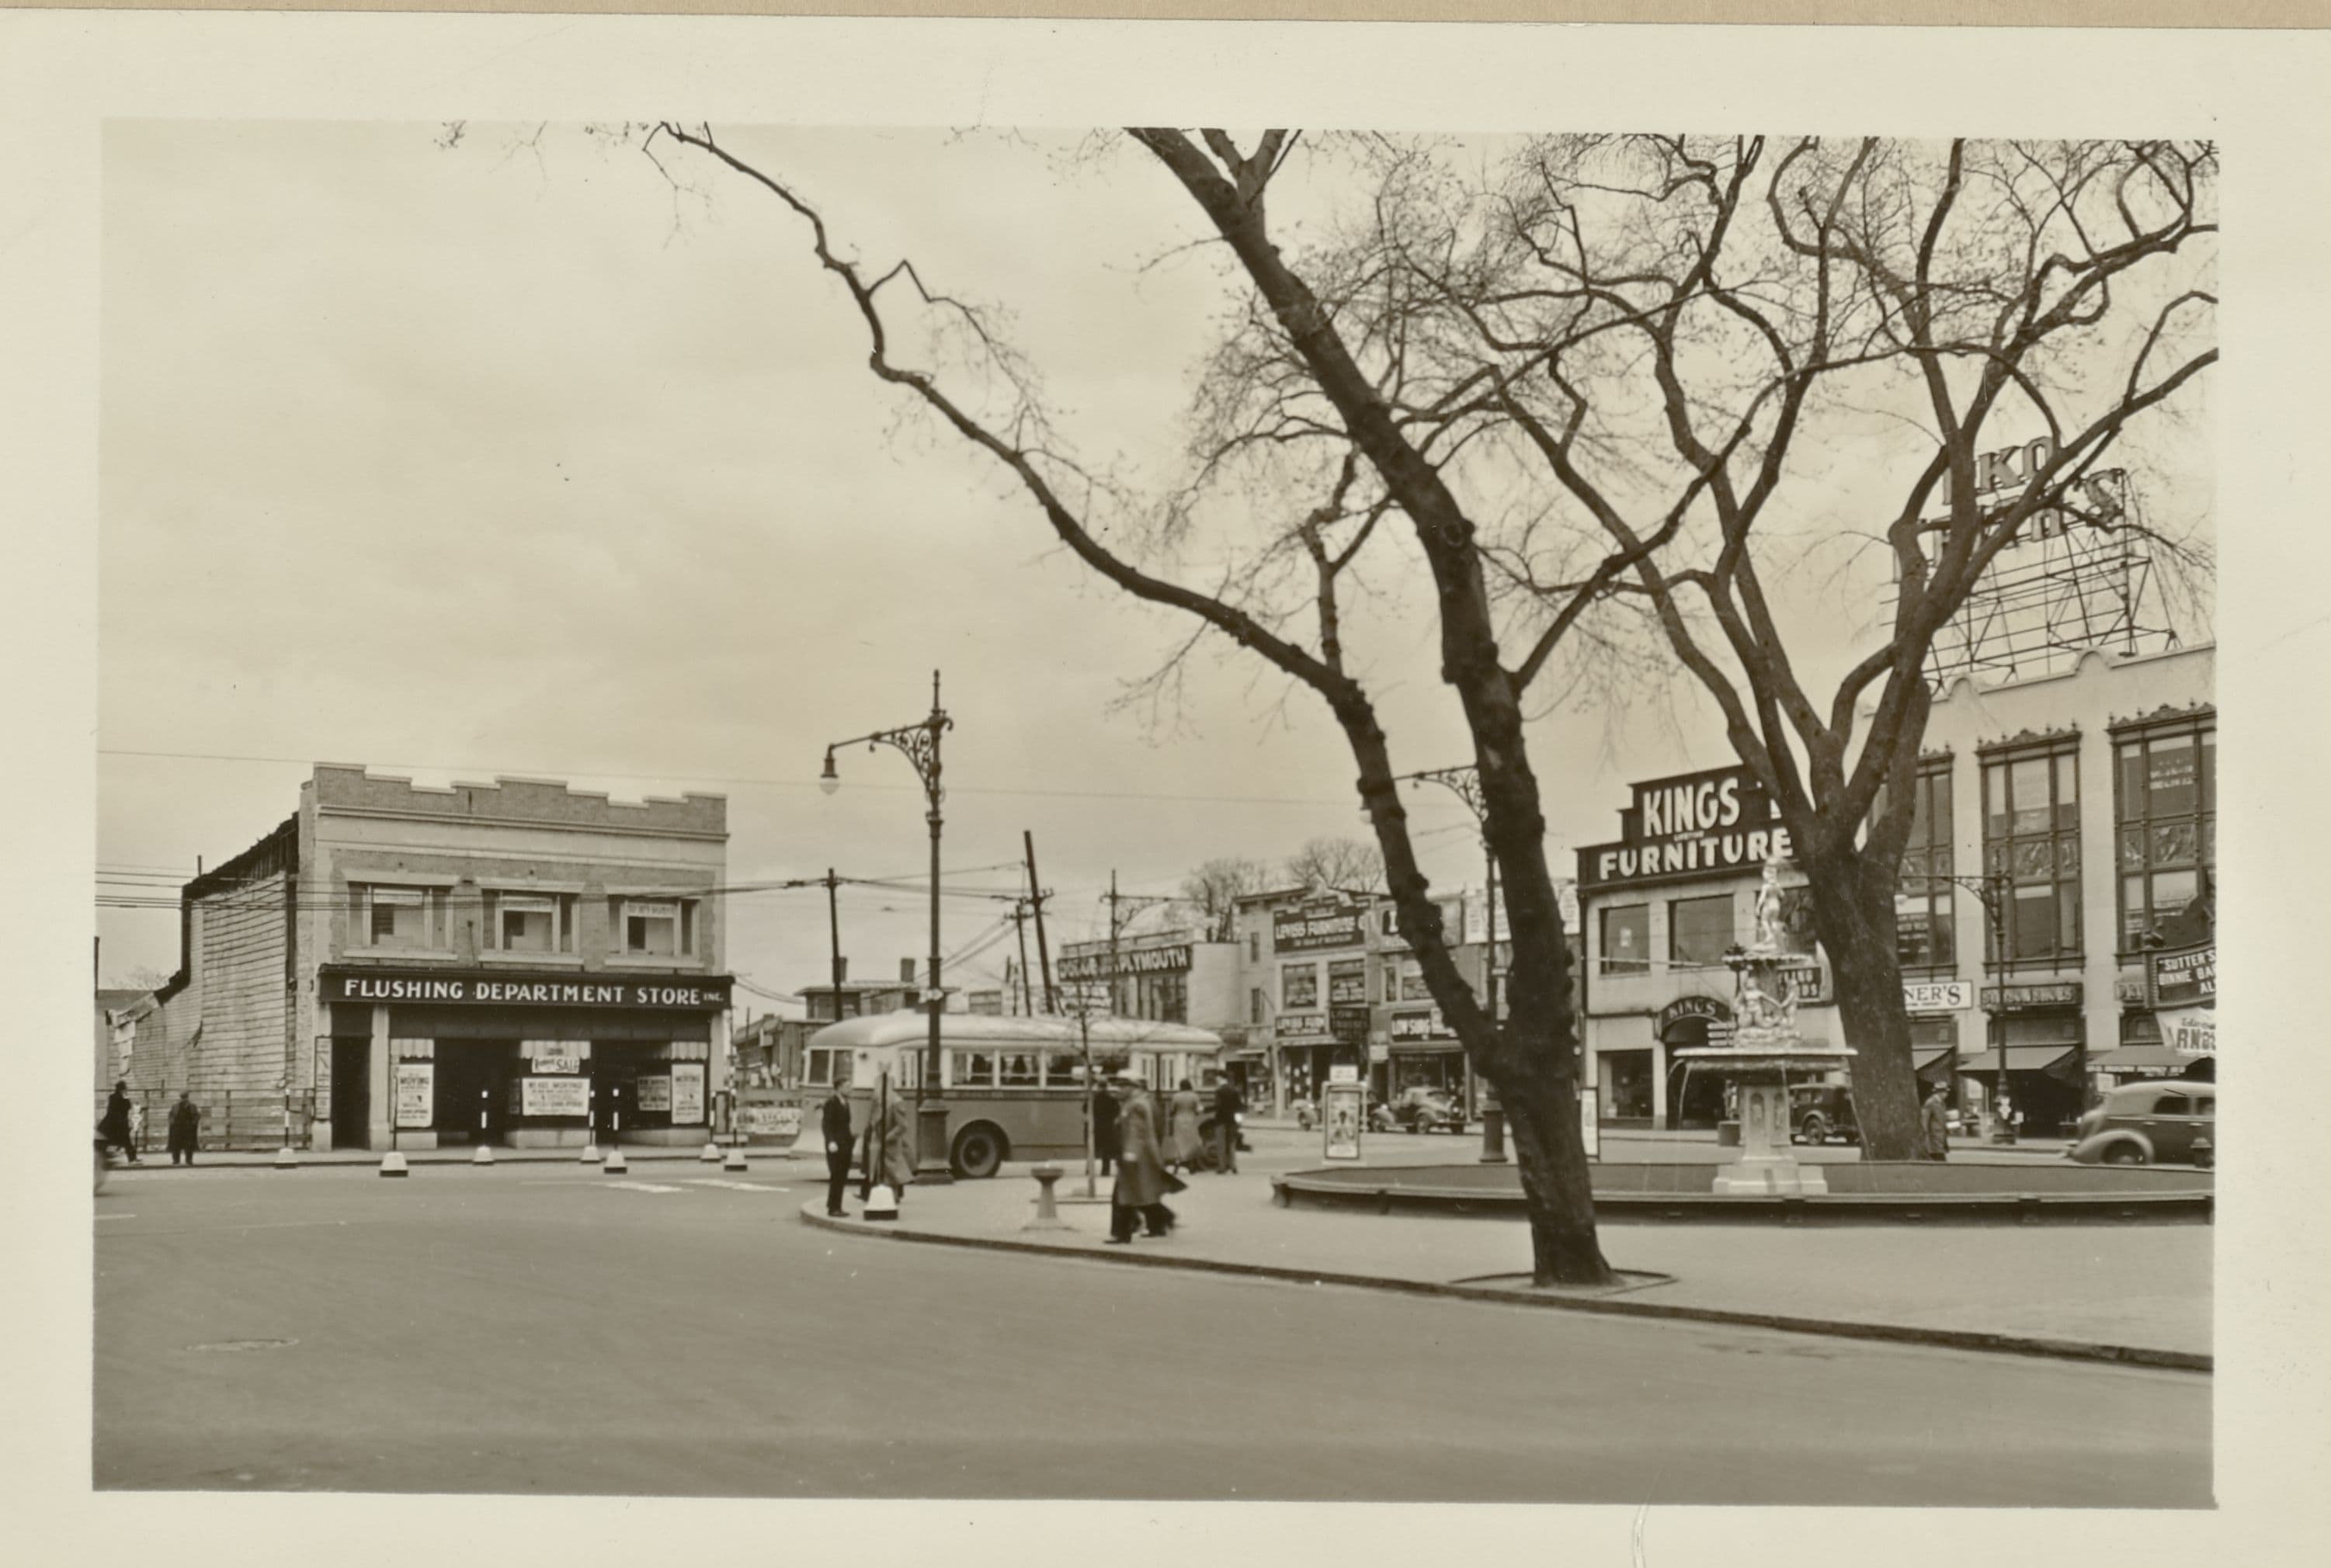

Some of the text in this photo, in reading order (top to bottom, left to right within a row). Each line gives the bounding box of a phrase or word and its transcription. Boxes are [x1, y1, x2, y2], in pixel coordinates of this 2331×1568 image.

[1943, 436, 2055, 505] KO
[1642, 776, 1741, 838] KINGS
[1598, 827, 1793, 880] FURNITURE
[1120, 947, 1187, 973] PLYMOUTH
[344, 979, 724, 1005] FLUSHING DEPARTMENT STORE INC.
[1903, 985, 1961, 1006] NER'S
[1667, 997, 1717, 1019] KINGS
